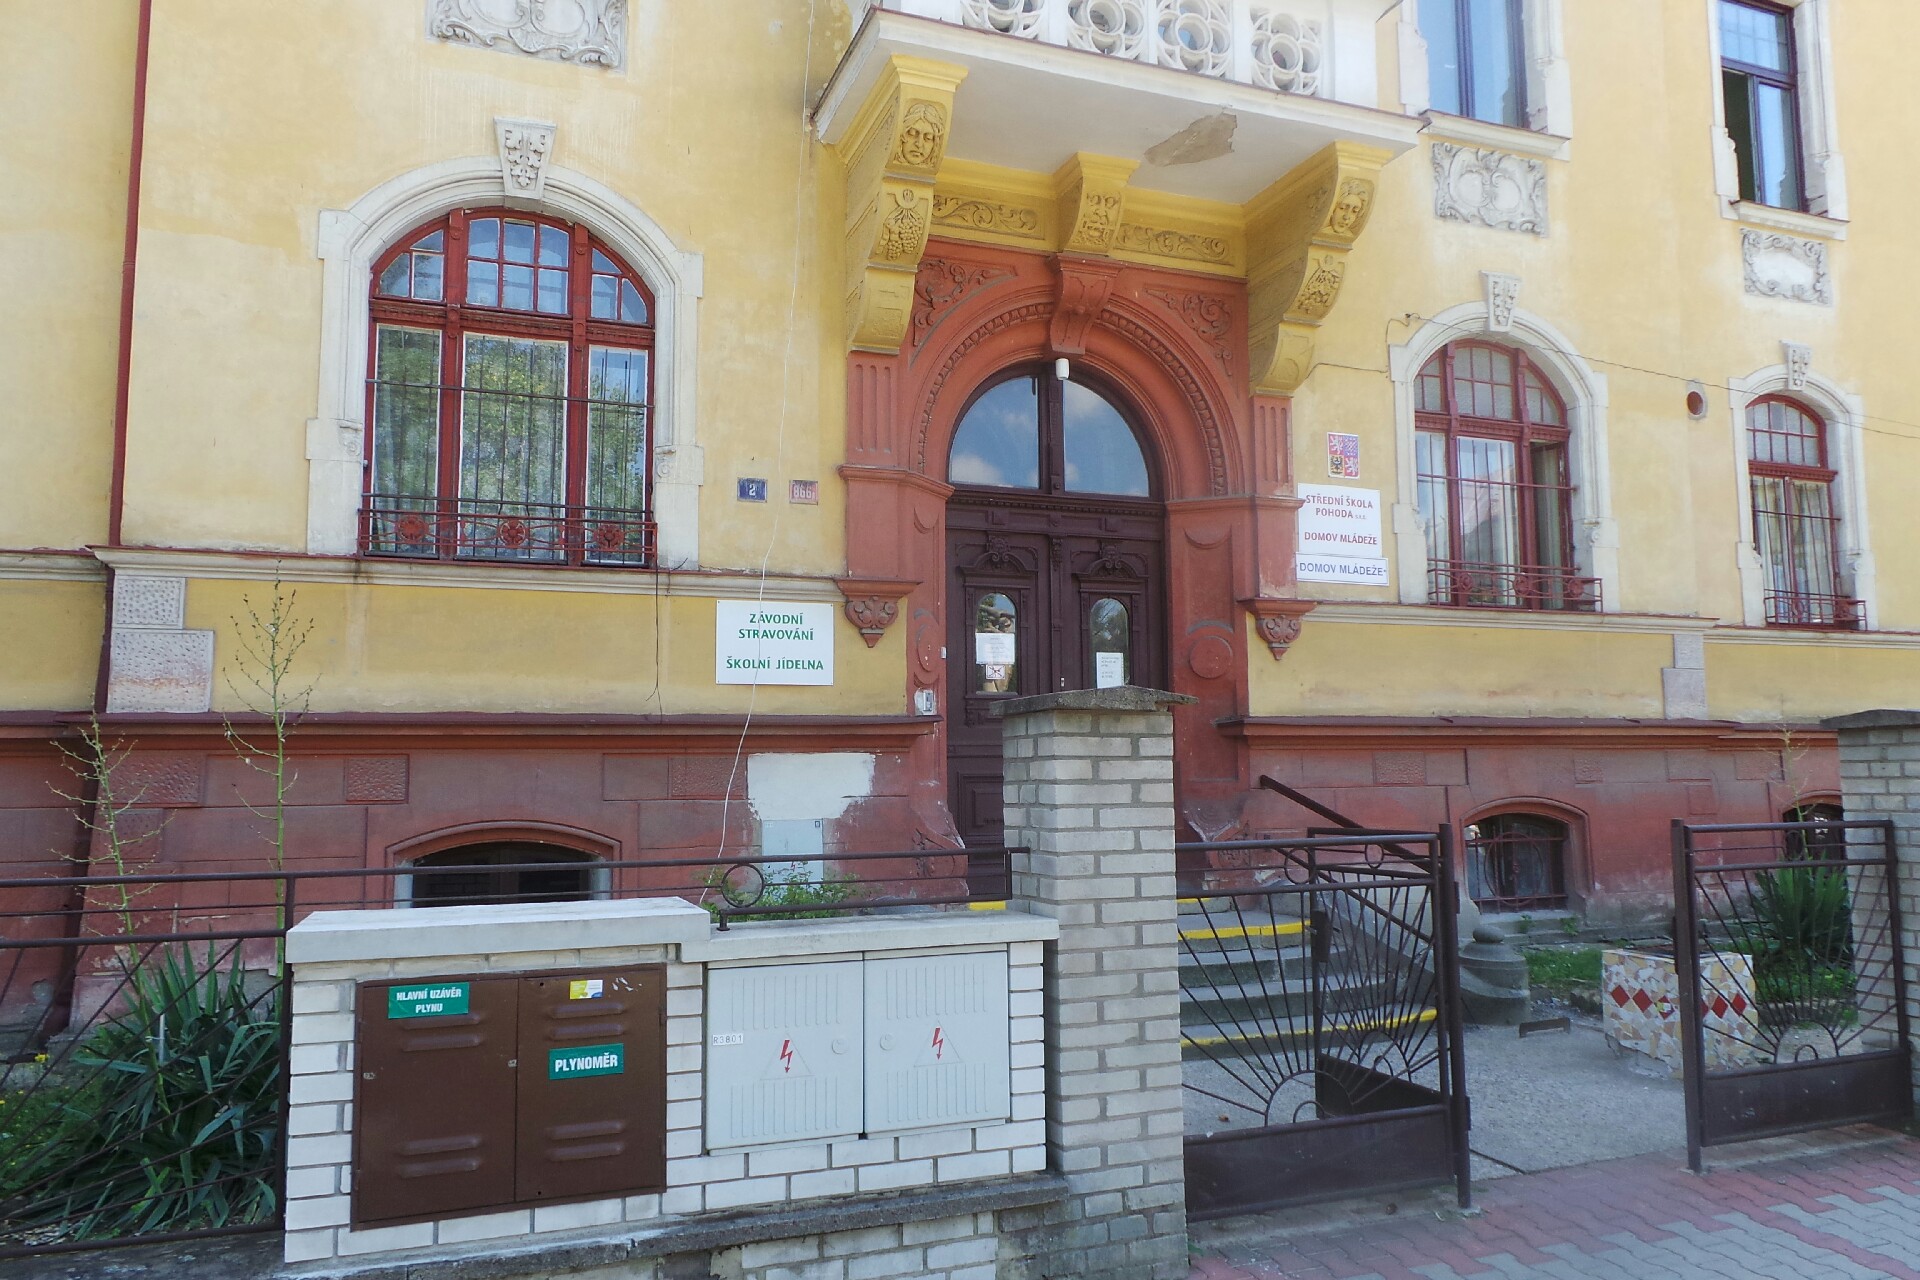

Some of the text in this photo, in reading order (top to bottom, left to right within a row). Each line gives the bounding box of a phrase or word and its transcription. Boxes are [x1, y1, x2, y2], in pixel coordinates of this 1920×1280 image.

[748, 483, 756, 496] 2
[1306, 493, 1373, 509] STŘEDNÍ ŠKOLA
[1315, 508, 1353, 519] POHODA
[1304, 532, 1378, 545] DOMOV MLÁDEŽE
[1299, 562, 1383, 576] DOMOV MLÁDEŽE
[749, 611, 803, 625] ZÁVODNÍ
[738, 628, 814, 641] STRAVOVÁNÍ
[726, 656, 824, 670] ŠKOLNÍ JÍDELNA
[396, 986, 462, 1001] HLAVNÍ UZÁVĚR
[415, 1003, 443, 1013] PLYNU
[554, 1052, 618, 1073] PLYNOMĚR
